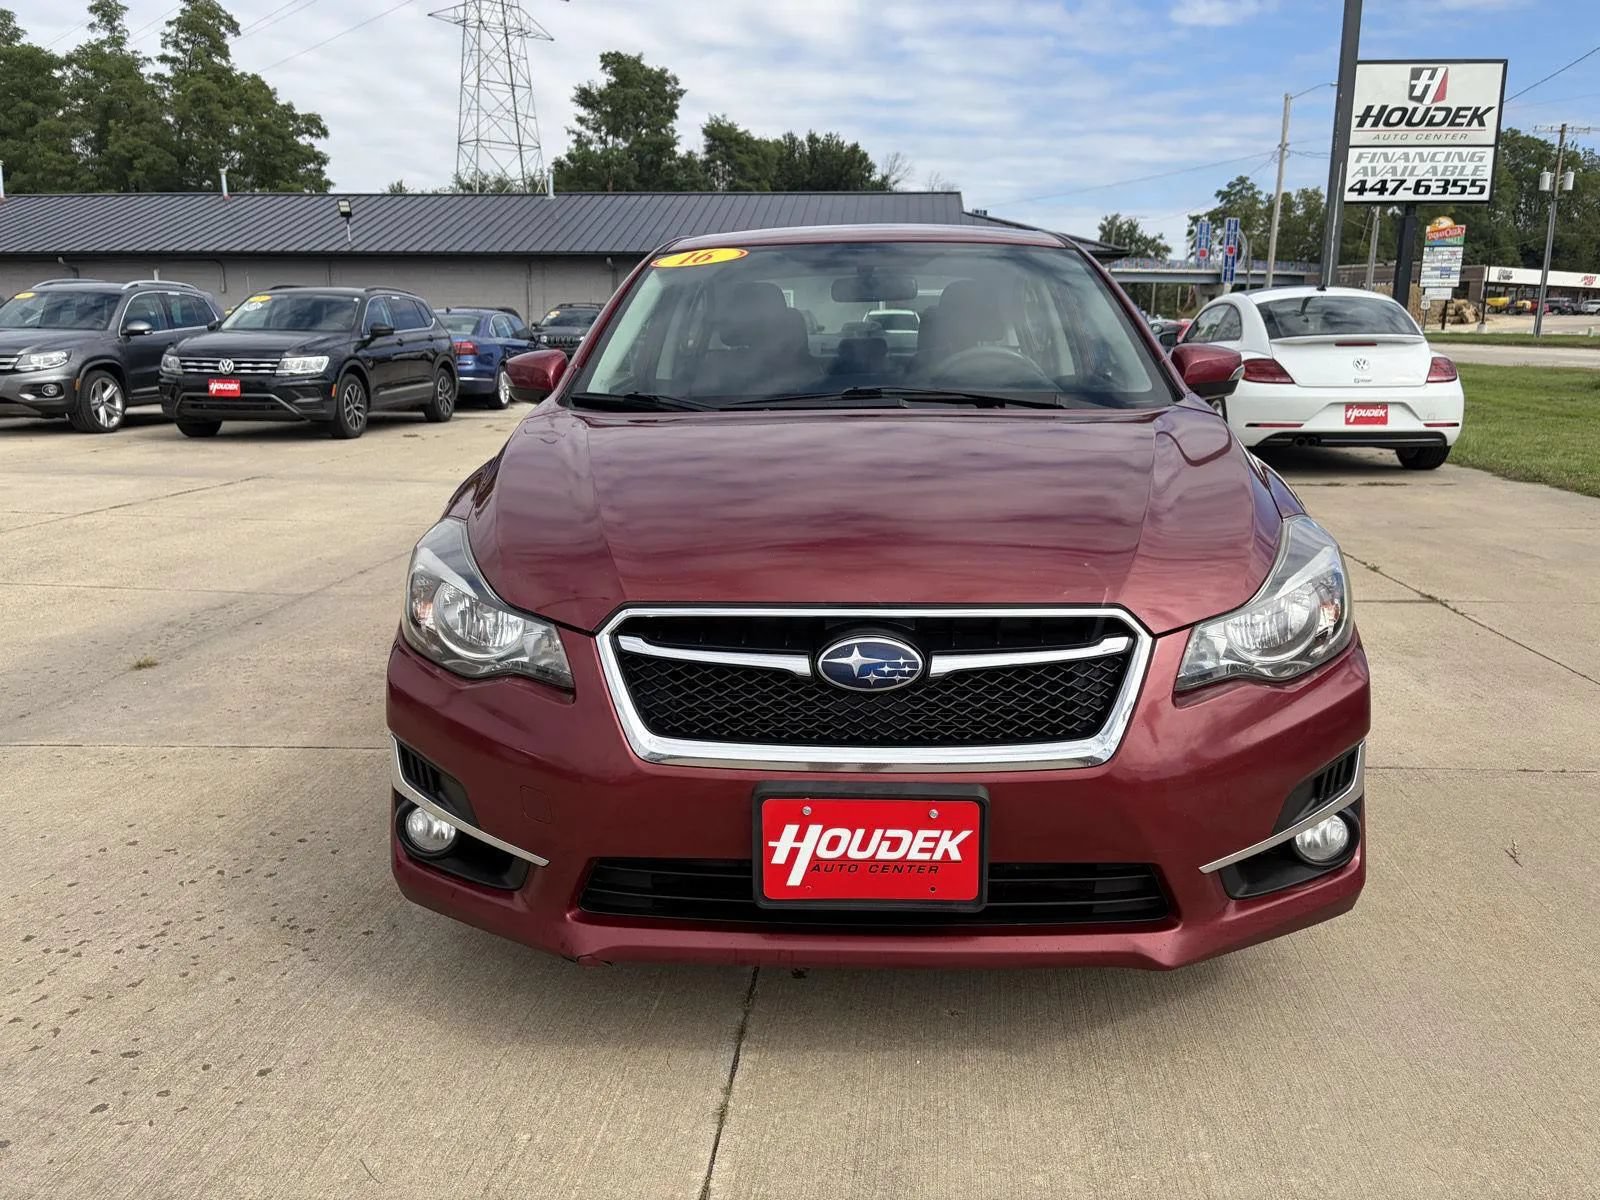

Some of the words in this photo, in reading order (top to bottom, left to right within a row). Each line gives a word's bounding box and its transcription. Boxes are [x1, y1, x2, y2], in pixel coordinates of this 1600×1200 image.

[1355, 105, 1496, 128] HOUDEK
[1372, 133, 1409, 141] AUTO
[1415, 133, 1468, 141] CENTER
[1354, 151, 1487, 164] FINANCING
[1352, 165, 1487, 177] AVAILABLE
[1347, 178, 1488, 196] 447-6355
[1345, 408, 1387, 423] HOUDEK
[768, 824, 974, 886] HOUDEK
[810, 863, 859, 873] AUTO
[868, 864, 939, 874] CENTER
